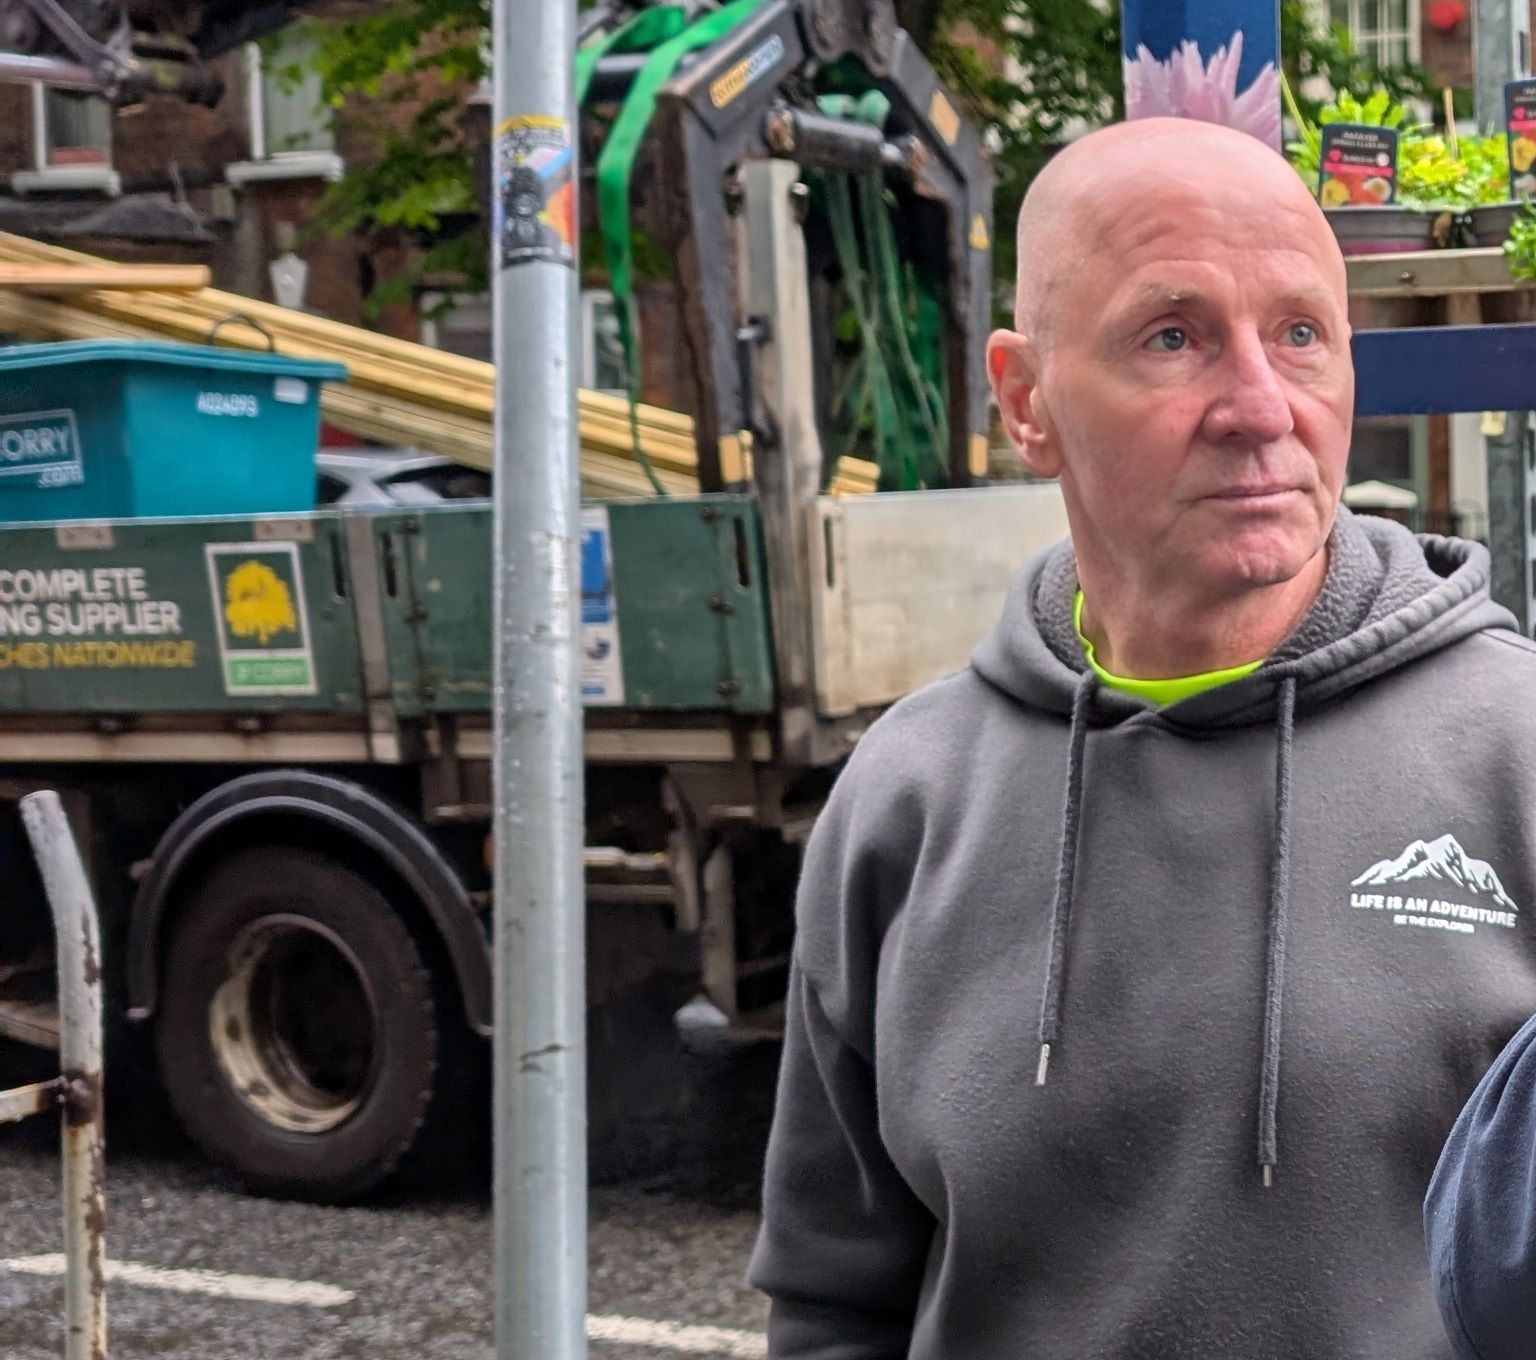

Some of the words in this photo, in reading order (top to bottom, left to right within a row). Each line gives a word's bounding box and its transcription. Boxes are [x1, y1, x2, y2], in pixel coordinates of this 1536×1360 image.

[0, 426, 70, 461] ORRY
[0, 567, 148, 603] COMPLETE
[47, 600, 182, 636] SUPPLIER
[54, 640, 196, 669] NATIONWIDE
[1350, 893, 1384, 910] LIFE
[1386, 895, 1403, 910] IS
[1405, 897, 1428, 913] AN
[1429, 900, 1517, 929] ADVENTURE
